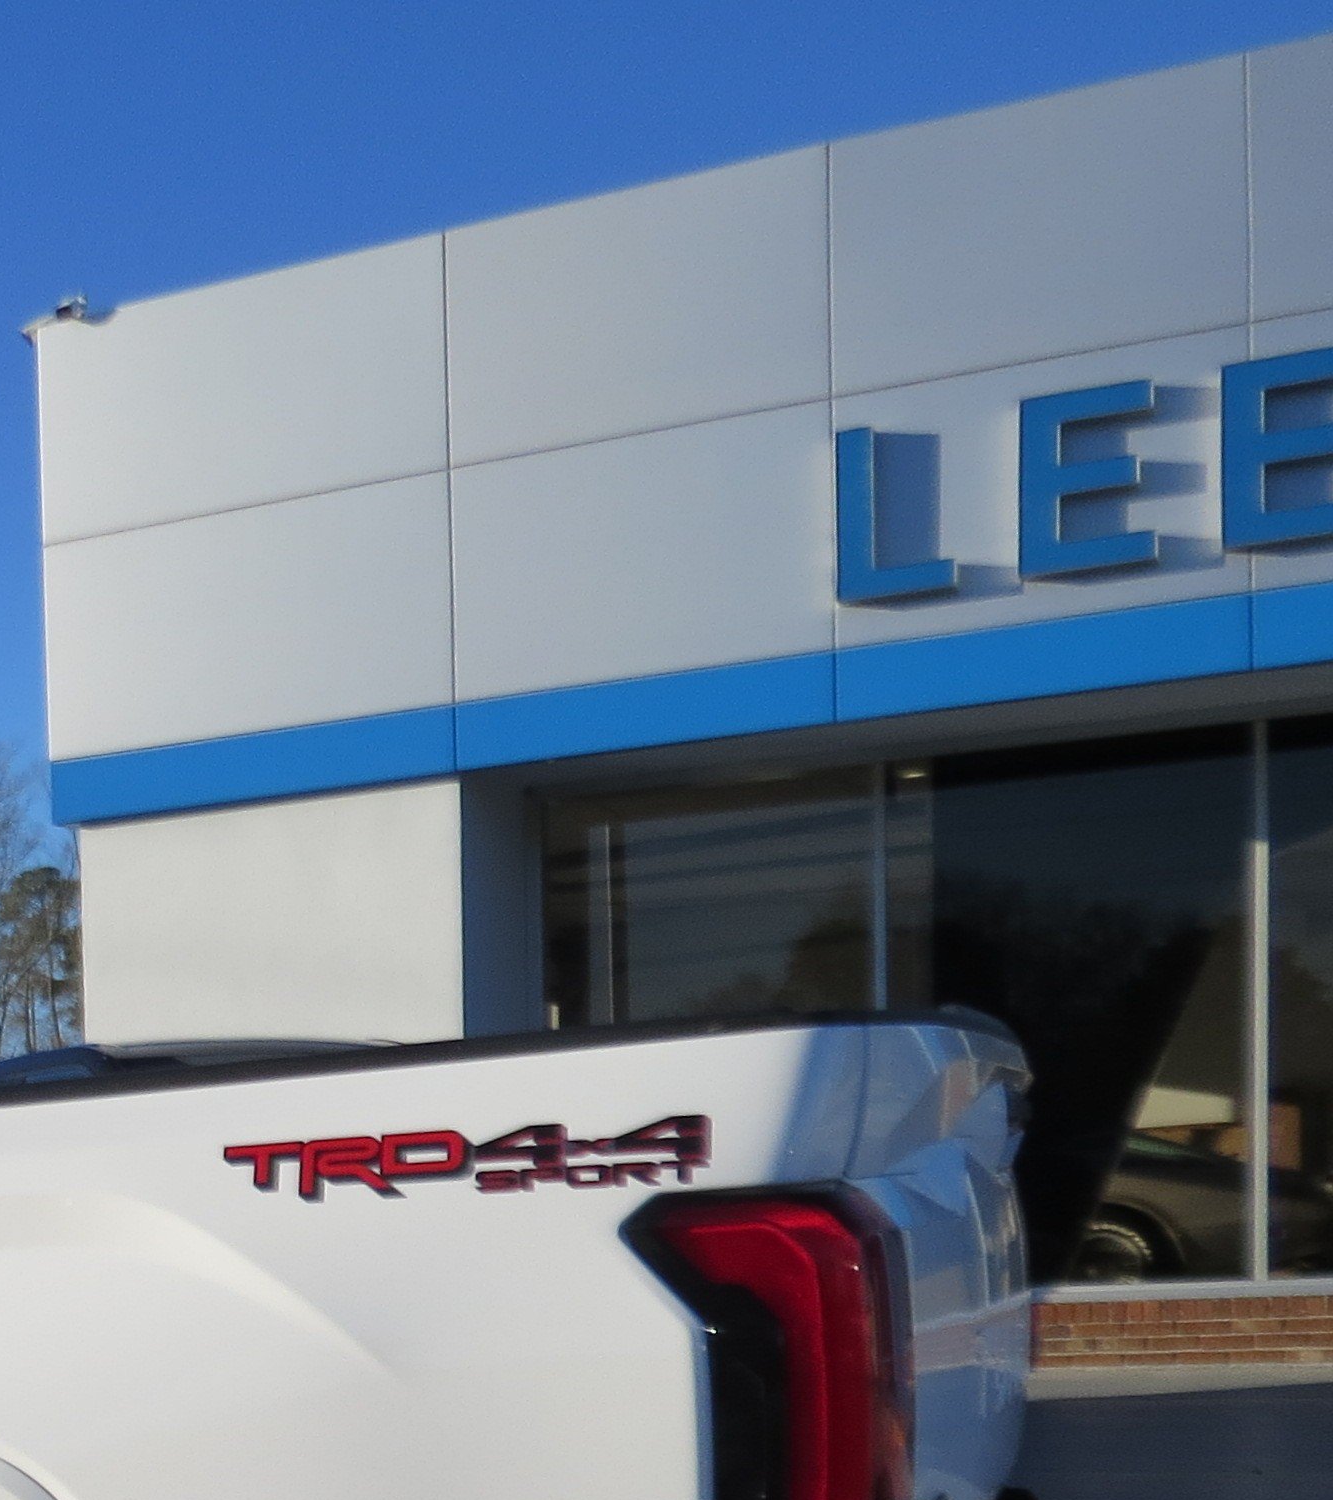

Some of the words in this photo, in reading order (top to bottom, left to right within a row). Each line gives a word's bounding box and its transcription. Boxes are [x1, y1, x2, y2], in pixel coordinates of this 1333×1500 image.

[836, 347, 1333, 602] LEE
[224, 1129, 475, 1201] TRD
[475, 1160, 710, 1193] SPORT
